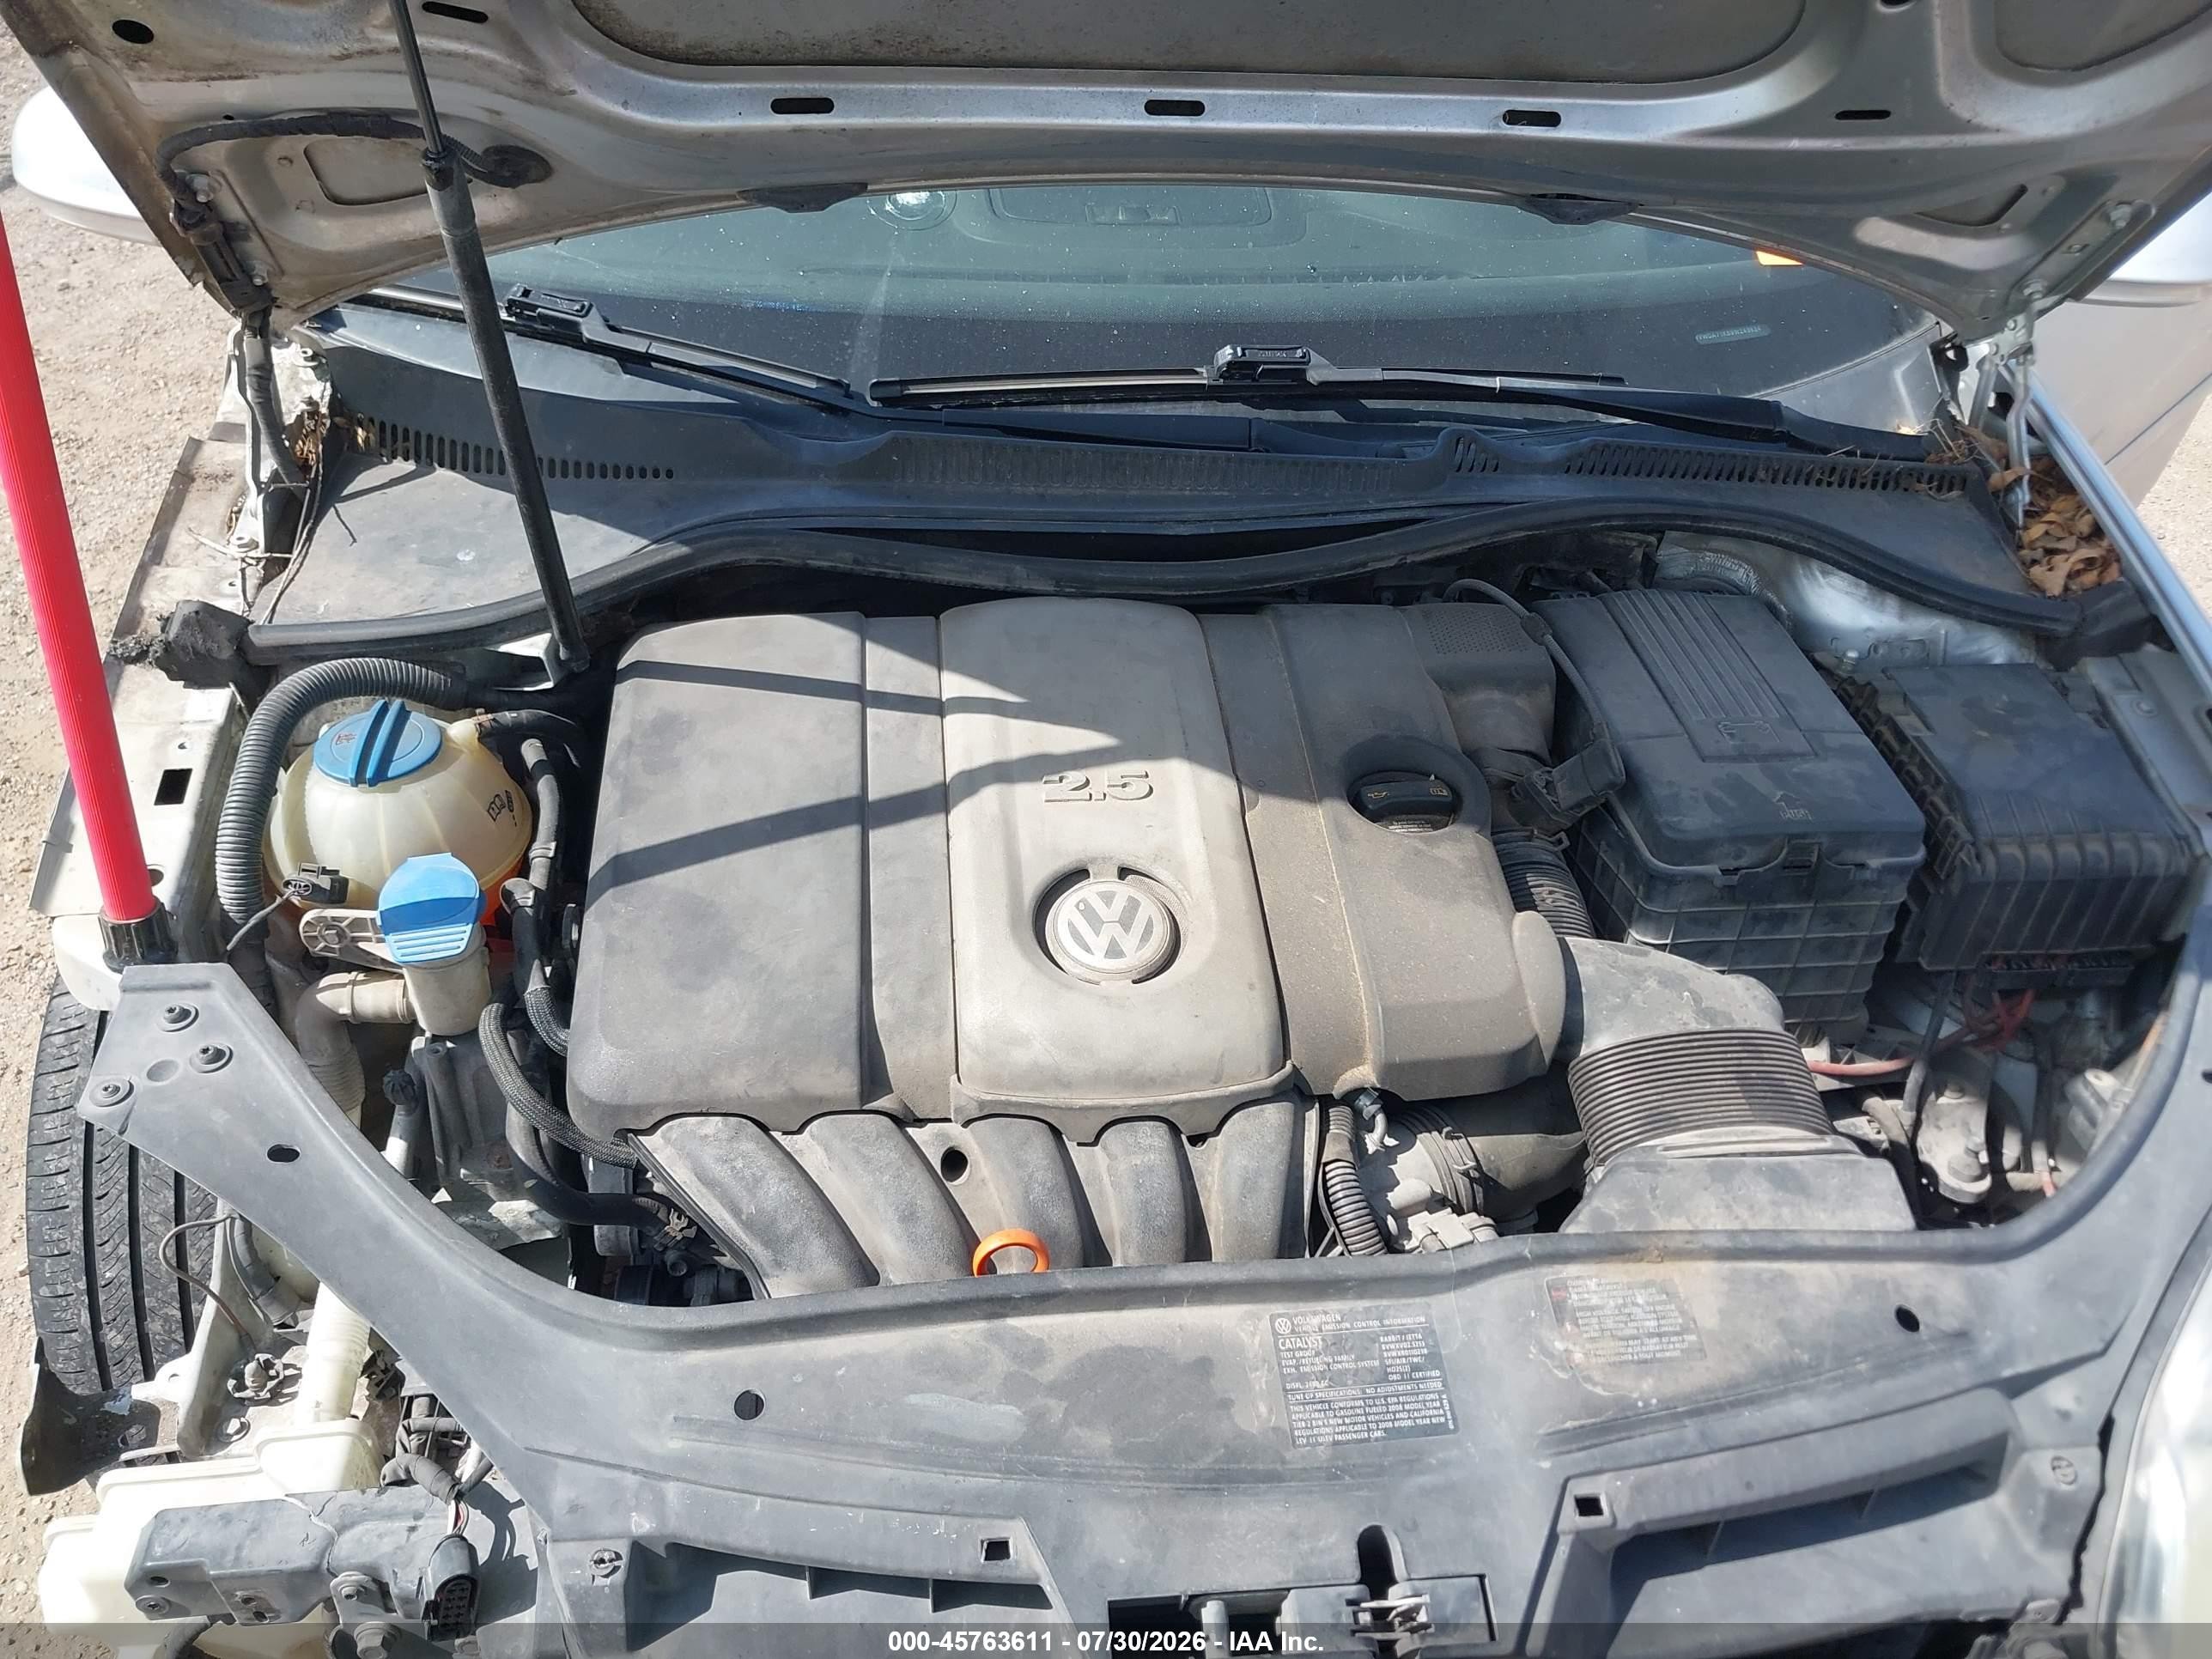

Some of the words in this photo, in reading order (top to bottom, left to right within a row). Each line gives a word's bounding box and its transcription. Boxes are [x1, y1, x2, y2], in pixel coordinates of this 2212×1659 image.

[1042, 771, 1153, 802] 2.5
[1055, 882, 1167, 971] VW
[1383, 1316, 1425, 1325] INFORMATION
[1279, 1336, 1322, 1349] CATALYST
[1399, 1393, 1439, 1401] REGULATIONS
[1294, 1427, 1333, 1435] REGULATIONS
